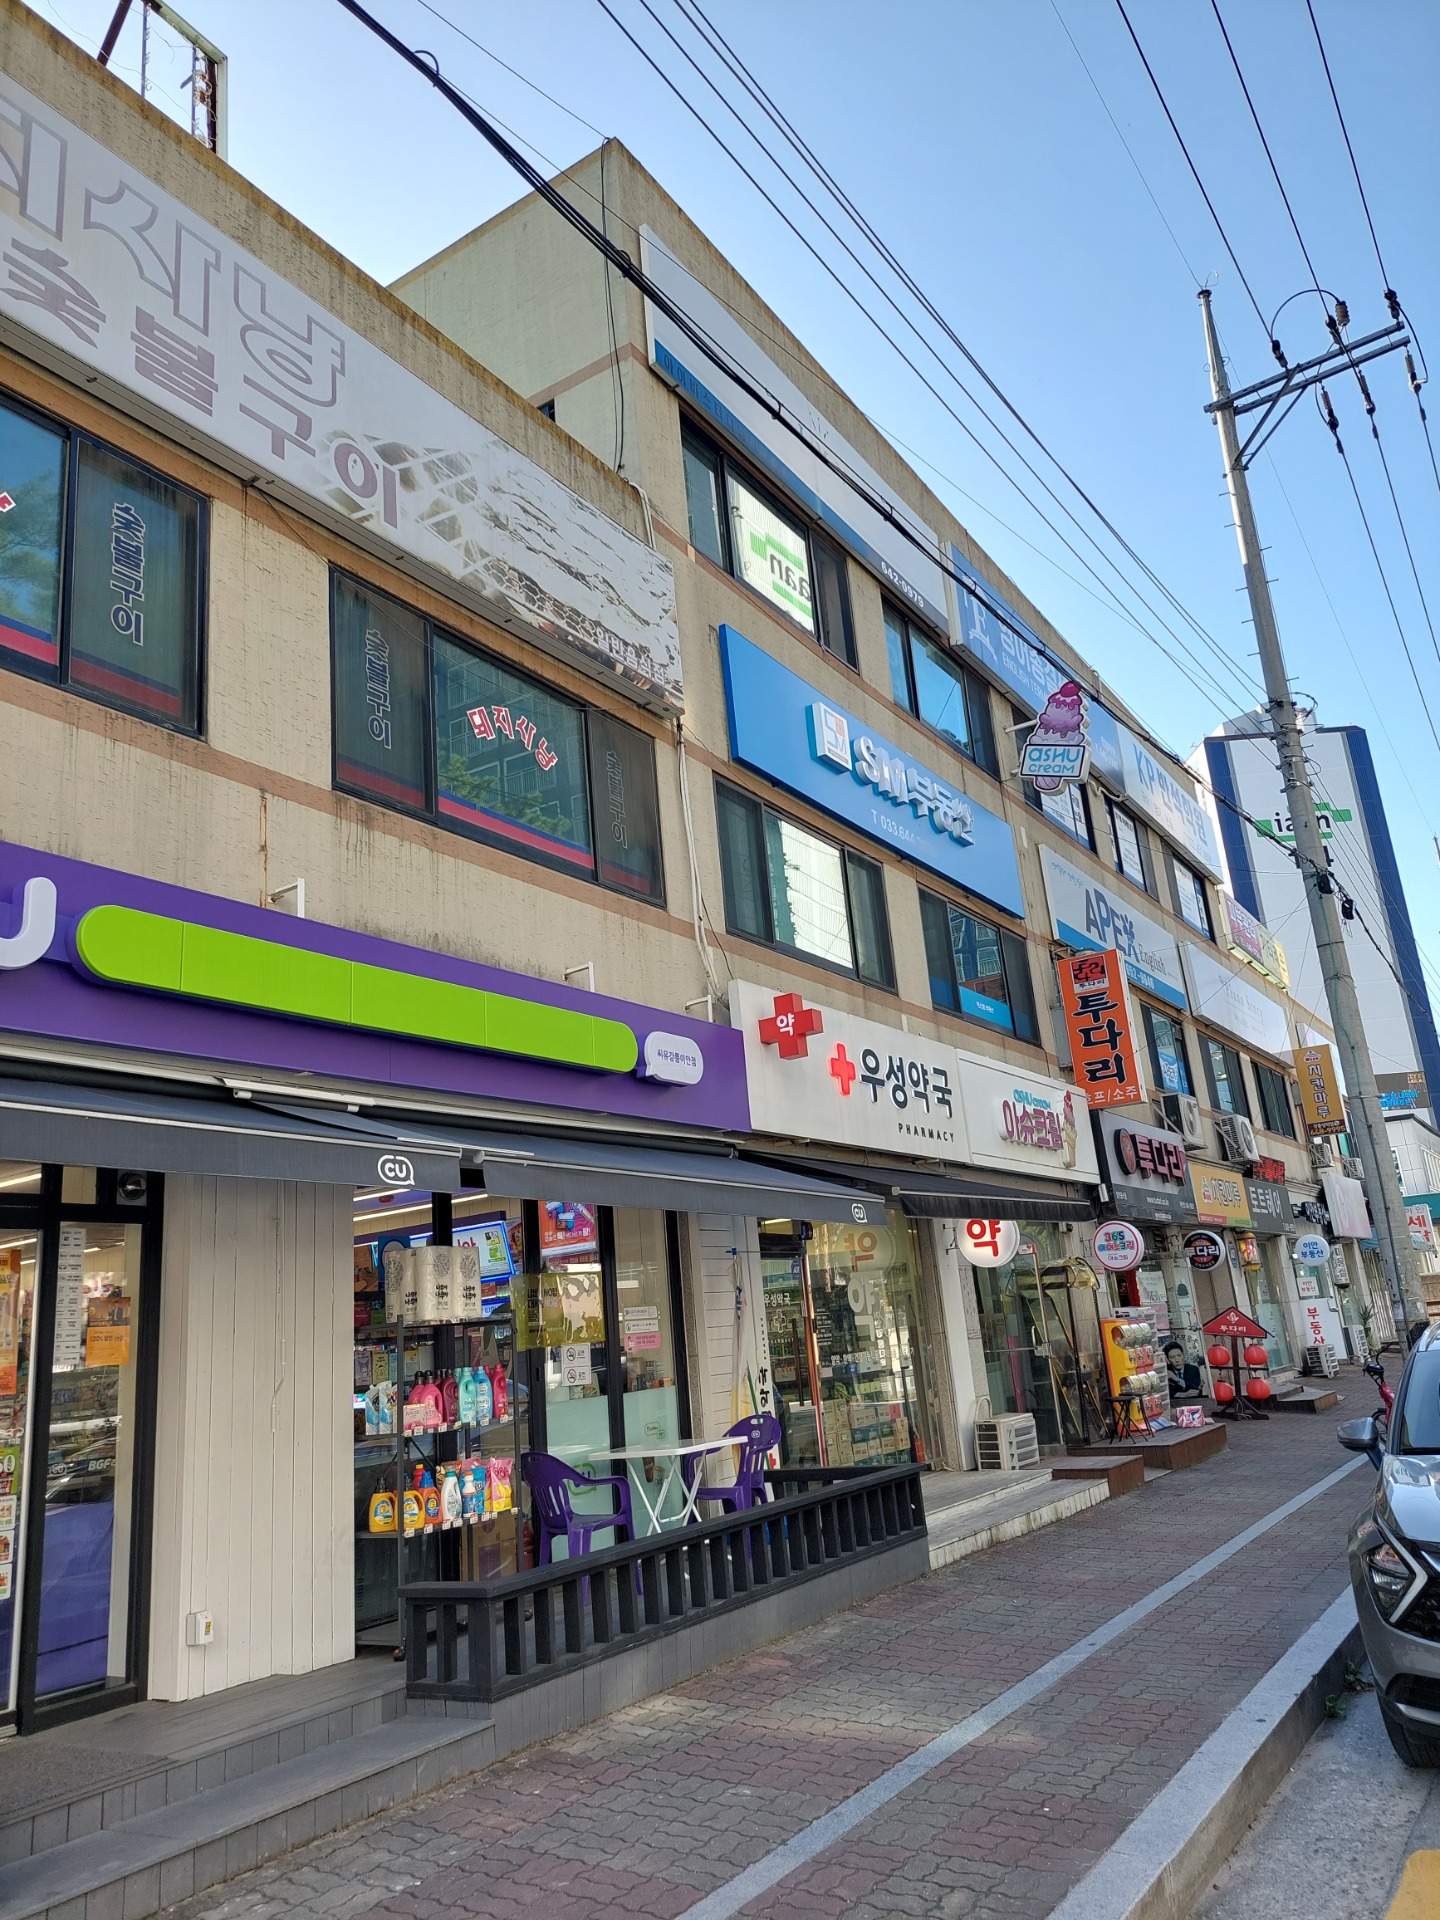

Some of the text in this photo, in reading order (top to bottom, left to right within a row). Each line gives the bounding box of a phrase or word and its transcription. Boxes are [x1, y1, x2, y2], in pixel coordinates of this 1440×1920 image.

[1, 237, 398, 530] 숯불구이
[111, 503, 145, 646] 숯불구이
[881, 561, 925, 608] 642-0979
[366, 628, 391, 749] 숯불구이
[776, 1012, 795, 1036] 약
[1072, 990, 1127, 1085] 투다리
[860, 1048, 954, 1119] 우성약국
[898, 1122, 955, 1143] PHARMACY
[1003, 1100, 1064, 1150] 아슈크림
[1134, 1133, 1186, 1186] 투다리
[966, 1219, 1001, 1257] 약
[1104, 1231, 1125, 1242] 365
[1301, 1250, 1325, 1259] 부동산
[1303, 1241, 1319, 1250] 이안
